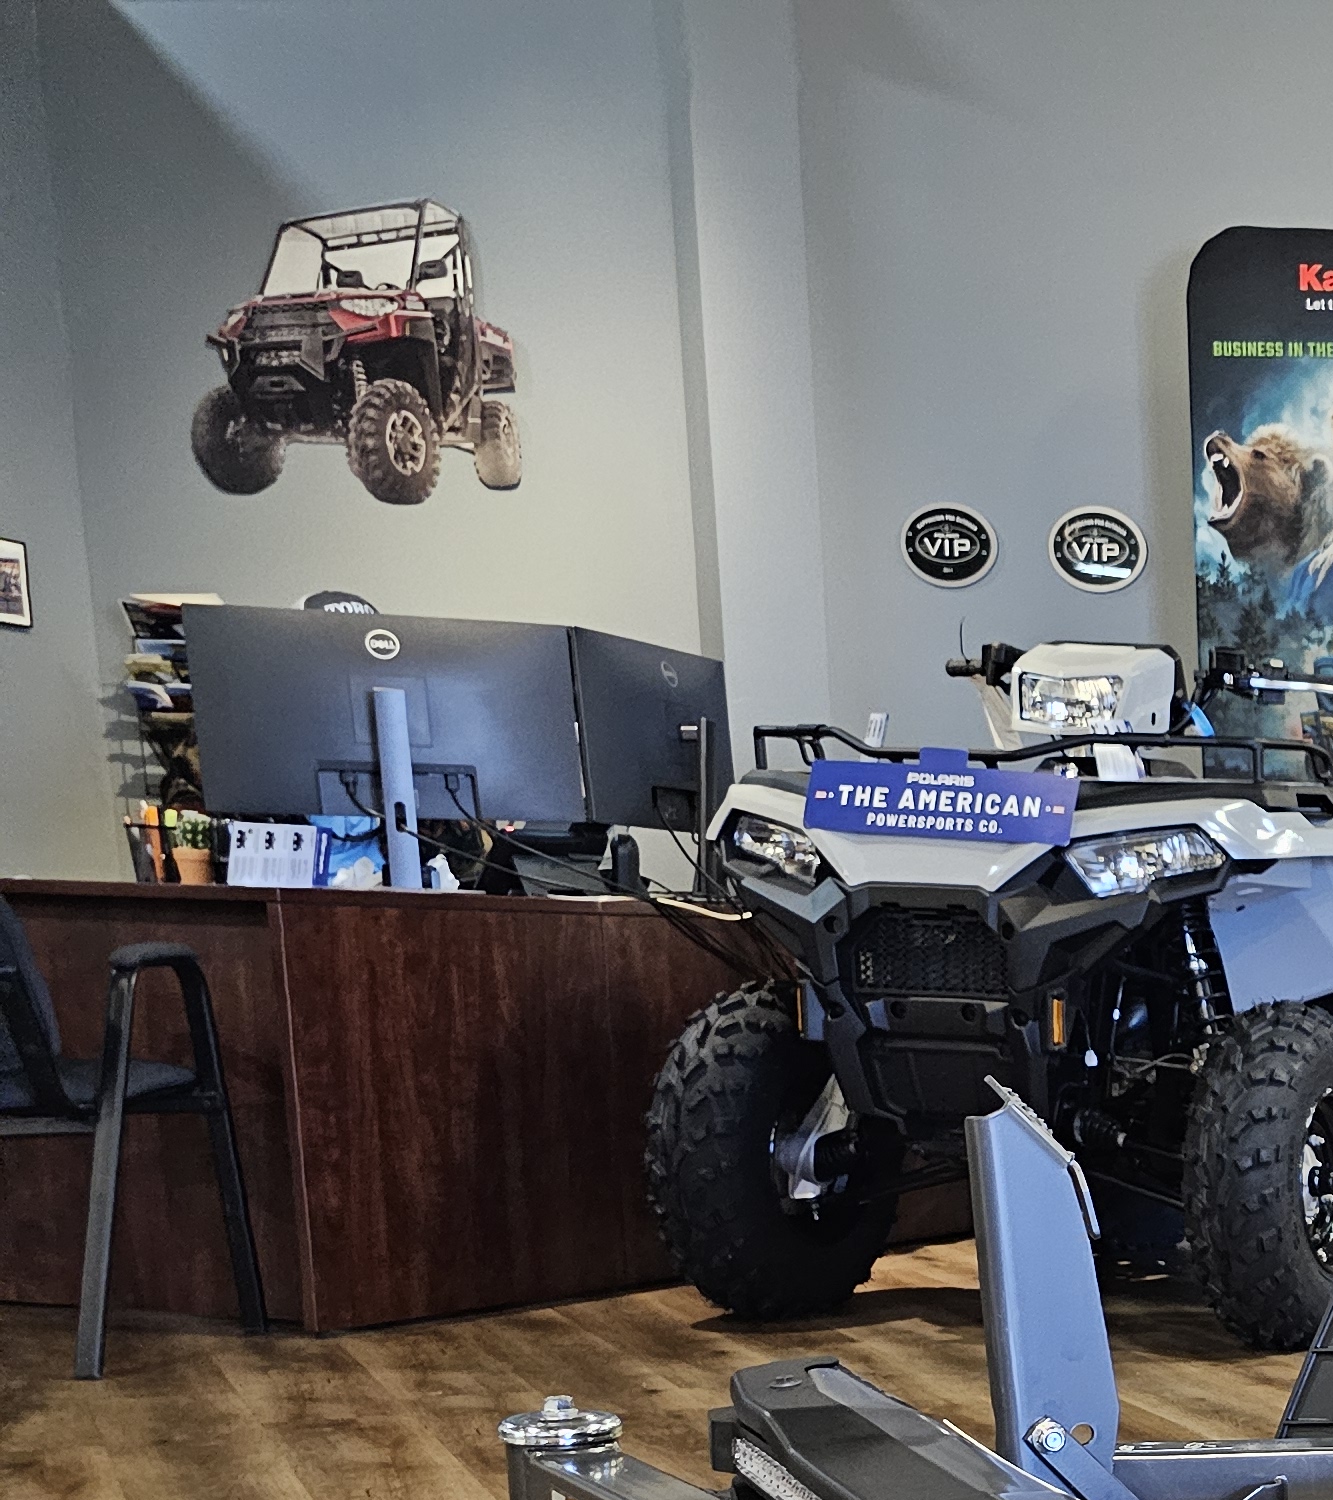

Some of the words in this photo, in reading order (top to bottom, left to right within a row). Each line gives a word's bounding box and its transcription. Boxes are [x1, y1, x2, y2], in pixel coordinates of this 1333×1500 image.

[1306, 298, 1326, 311] Let
[1213, 341, 1284, 358] BUSINESS
[1288, 342, 1304, 358] IN
[923, 538, 971, 557] VIP
[1071, 542, 1120, 562] VIP
[369, 638, 396, 650] DELL
[907, 772, 975, 787] POLARIS
[838, 784, 890, 808] THE
[898, 788, 1042, 817] AMERICAN
[866, 812, 974, 832] POWERSPORTS
